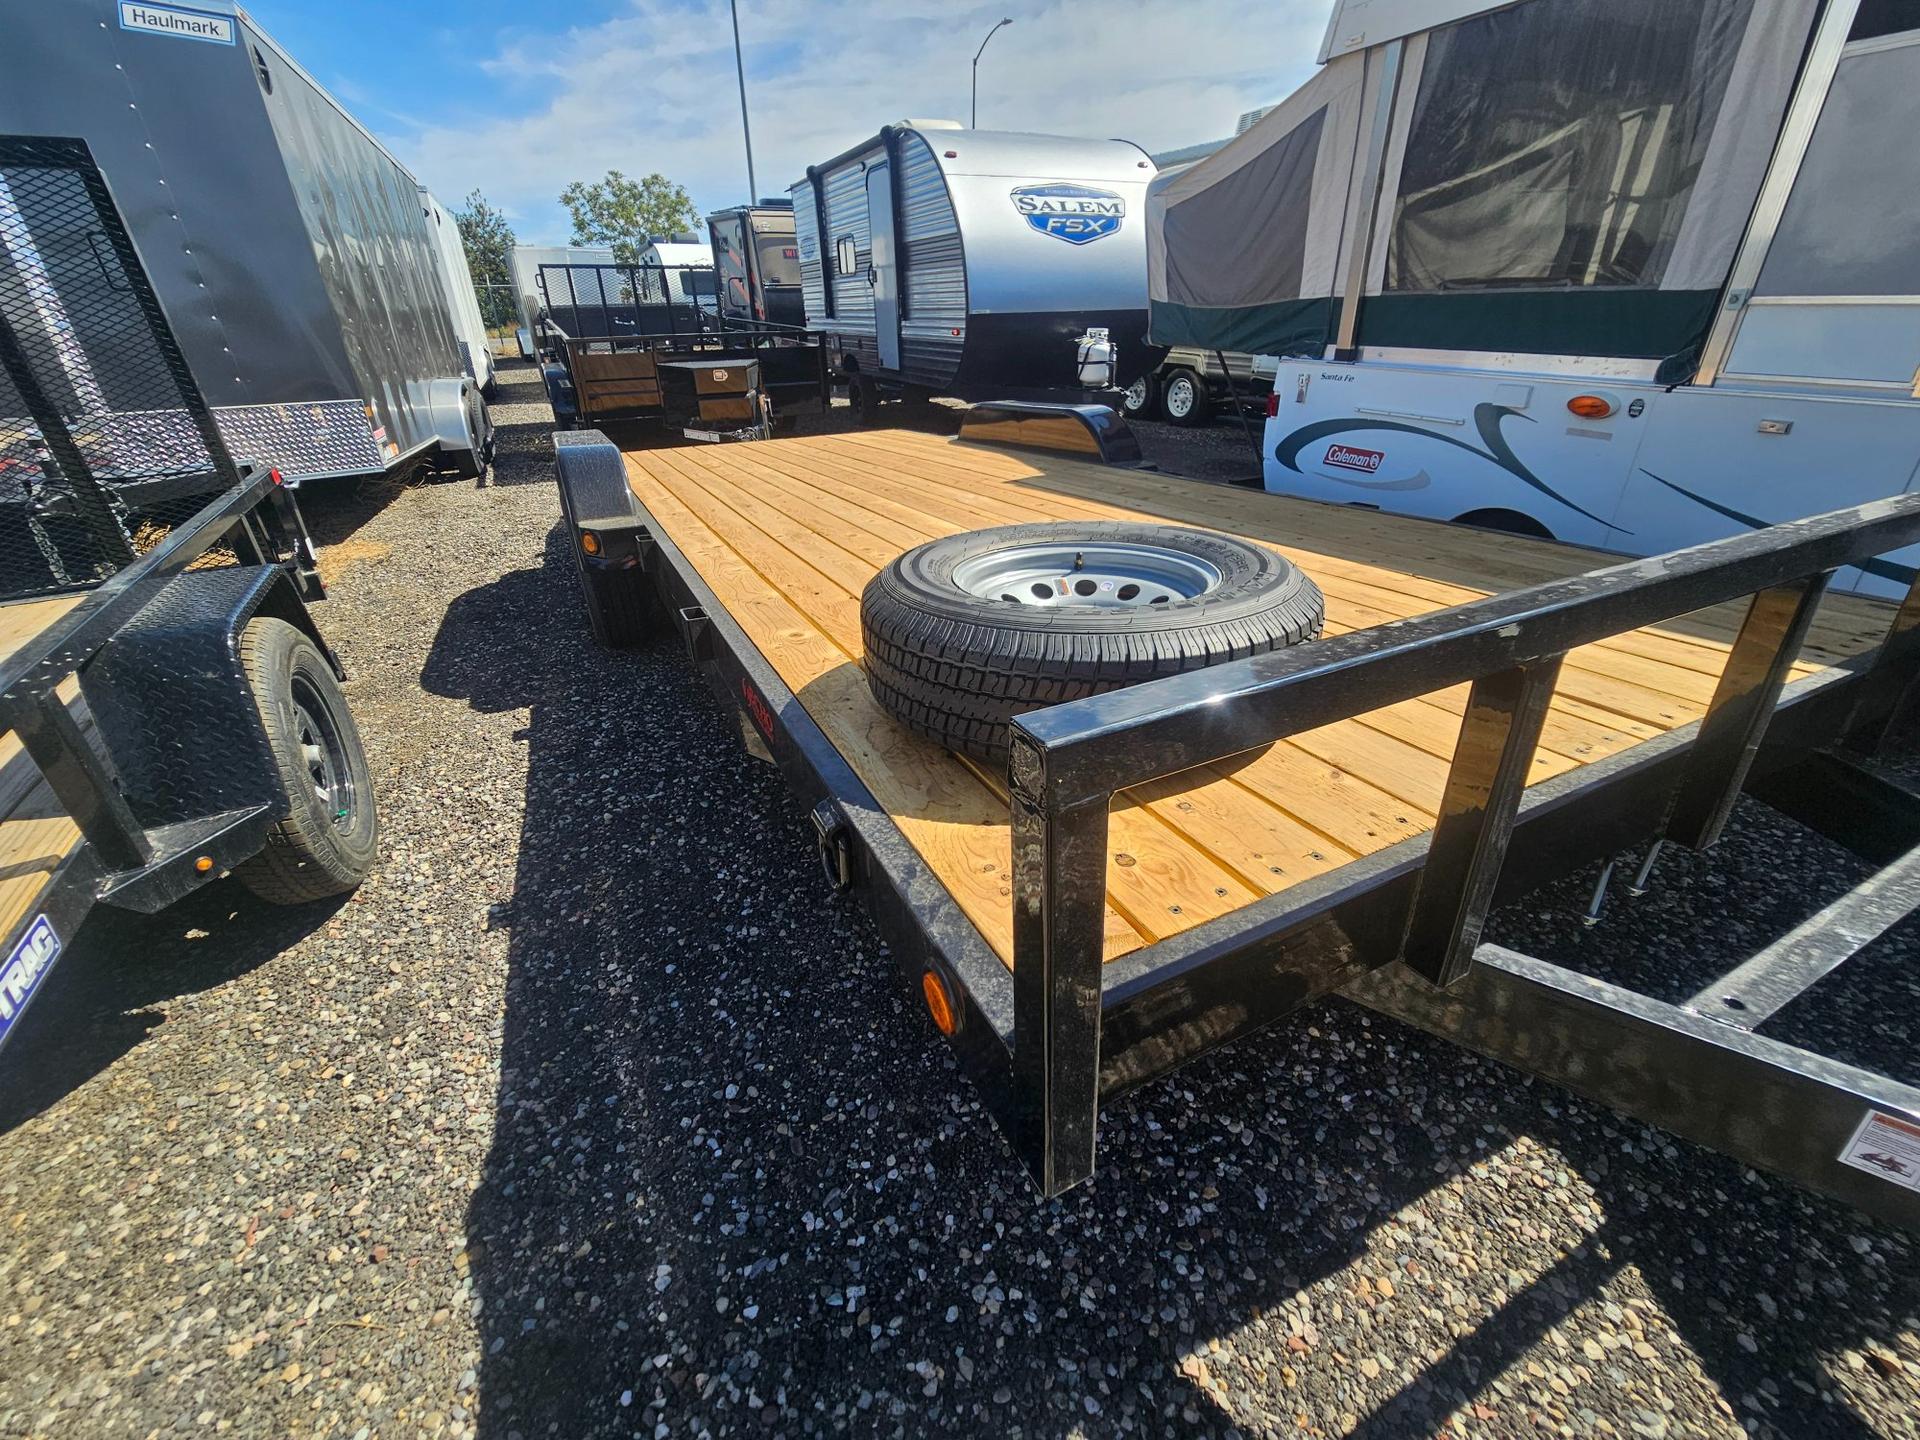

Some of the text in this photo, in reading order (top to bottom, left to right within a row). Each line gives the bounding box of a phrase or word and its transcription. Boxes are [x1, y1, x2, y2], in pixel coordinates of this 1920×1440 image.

[132, 8, 220, 36] Haulmark
[1018, 197, 1122, 214] SALEM
[1046, 217, 1107, 233] FSX
[1321, 372, 1355, 383] Santa Fe
[1328, 446, 1370, 467] Coleman
